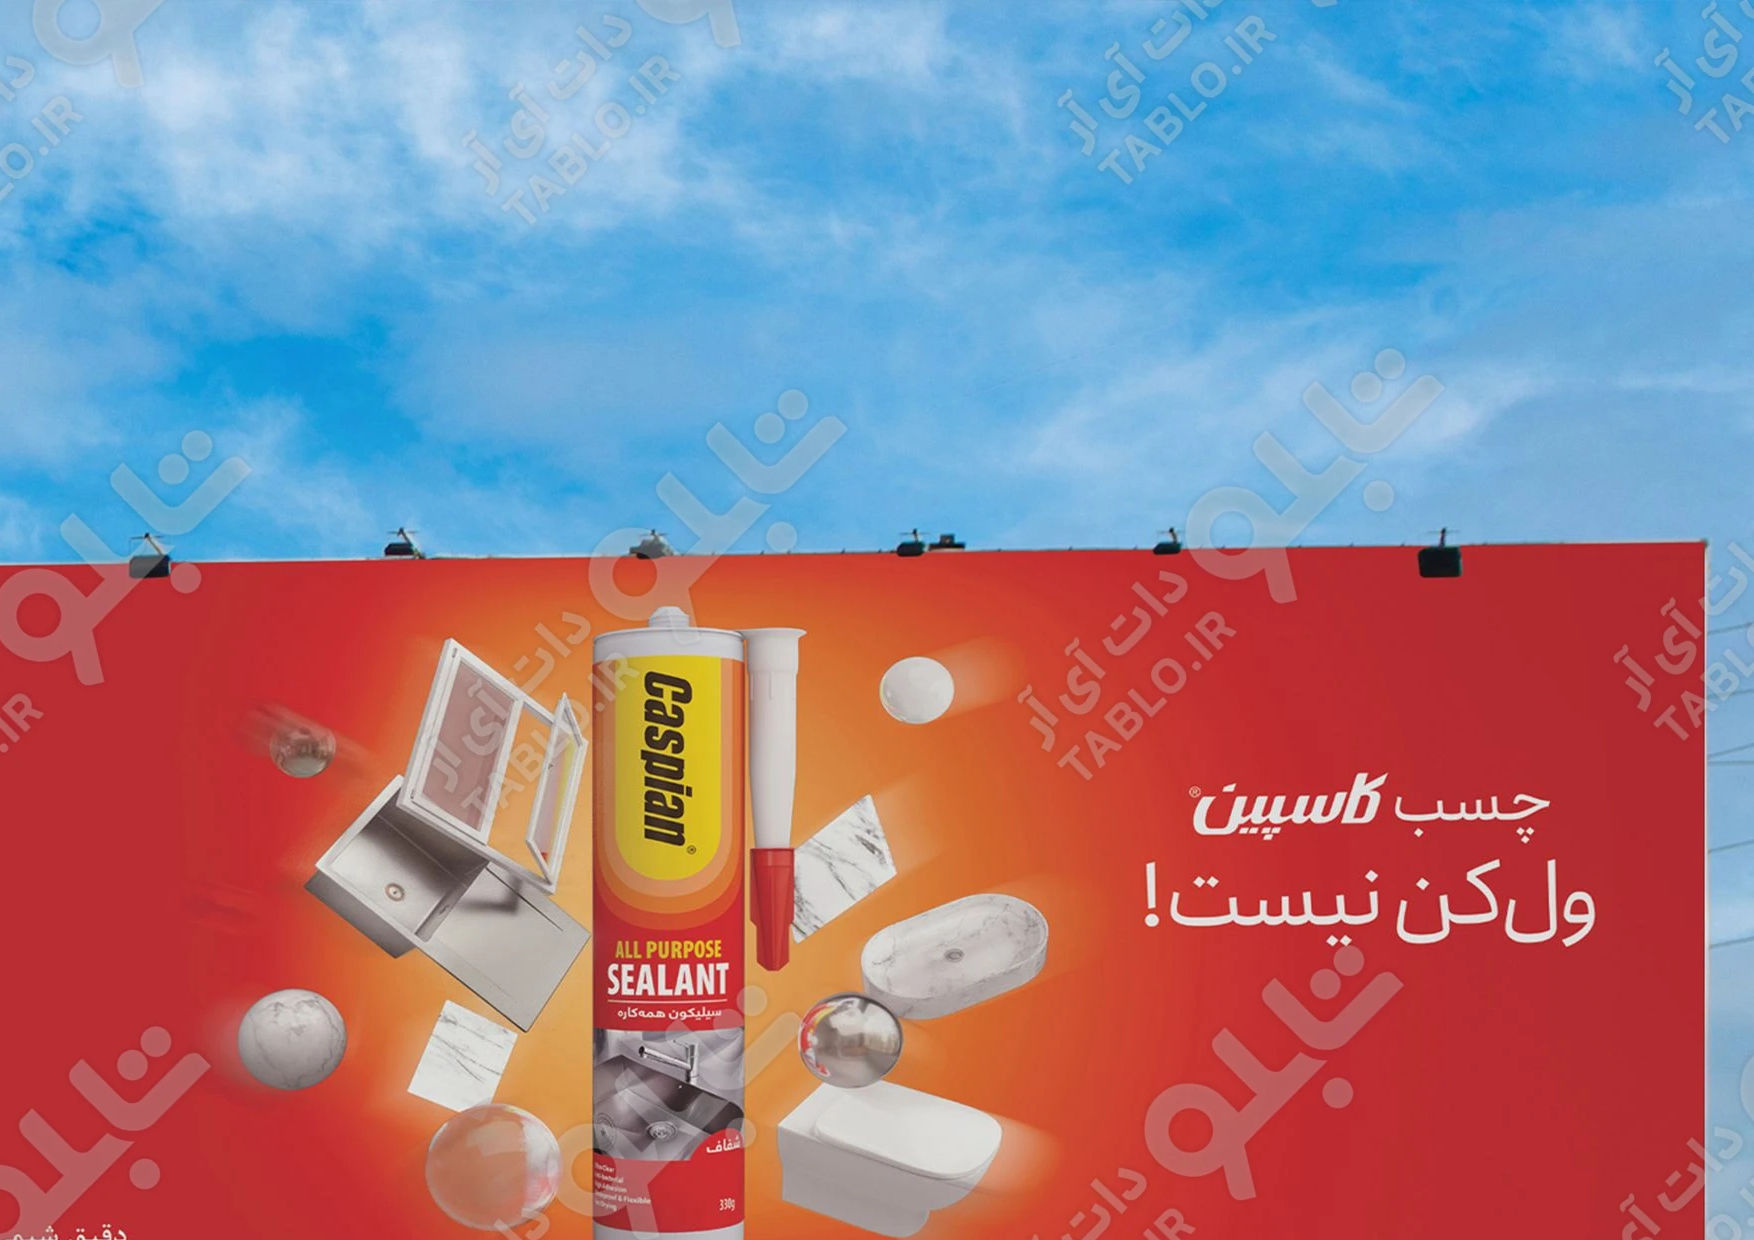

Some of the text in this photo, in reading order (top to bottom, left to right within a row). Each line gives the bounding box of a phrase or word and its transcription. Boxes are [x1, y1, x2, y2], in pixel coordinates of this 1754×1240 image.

[640, 670, 693, 847] Caspian
[1192, 772, 1551, 844] چسب کاسپین
[1144, 861, 1379, 948] نیست!
[607, 963, 730, 996] SEALANT
[615, 939, 722, 959] ALL PURPOSE
